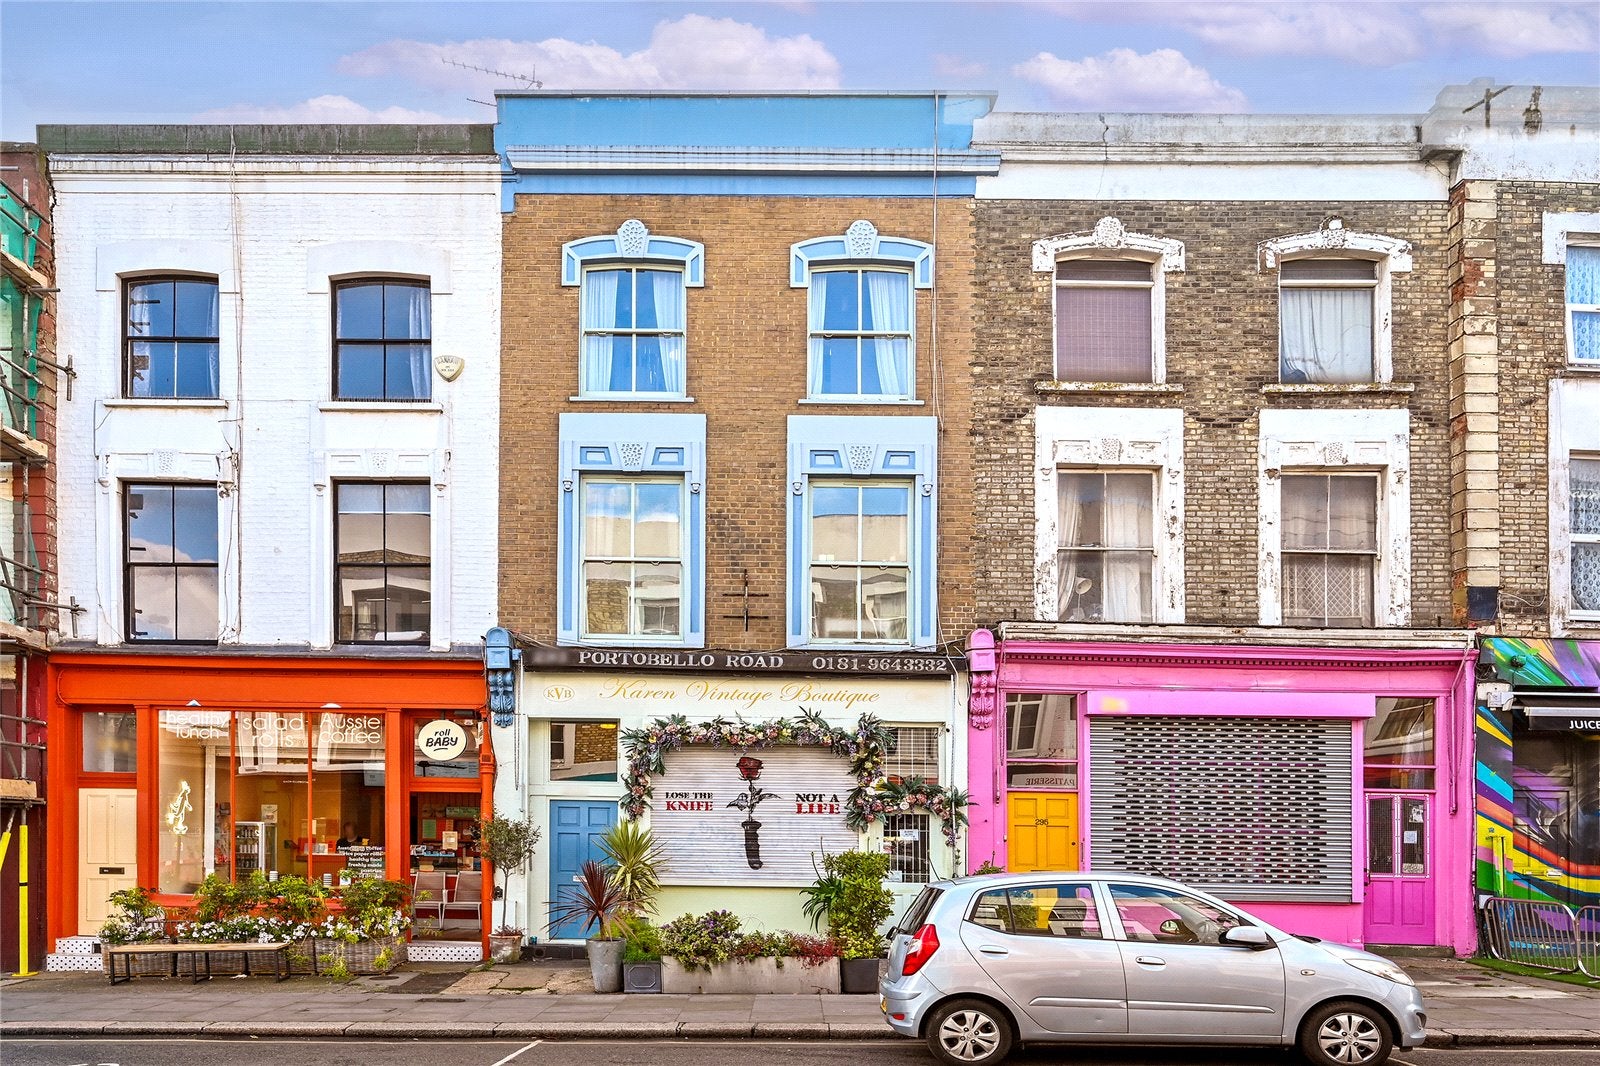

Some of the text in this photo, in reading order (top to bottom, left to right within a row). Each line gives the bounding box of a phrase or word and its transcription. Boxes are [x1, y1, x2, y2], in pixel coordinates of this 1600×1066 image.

[578, 651, 715, 667] PORTOBELLO
[725, 655, 784, 668] ROAD
[812, 656, 947, 671] 0181-9643332
[547, 687, 572, 699] KVB
[599, 678, 880, 709] Karen Vintage Boutique
[167, 709, 229, 728] healthy
[242, 711, 303, 731] salad
[320, 712, 380, 729] Aussie
[176, 726, 220, 739] lunch
[252, 730, 294, 747] rolls
[320, 728, 380, 743] coffee
[434, 729, 451, 737] roll
[426, 737, 458, 747] BABY
[795, 793, 840, 802] NOT A
[665, 801, 714, 811] KNIFE
[796, 803, 841, 814] LIFE
